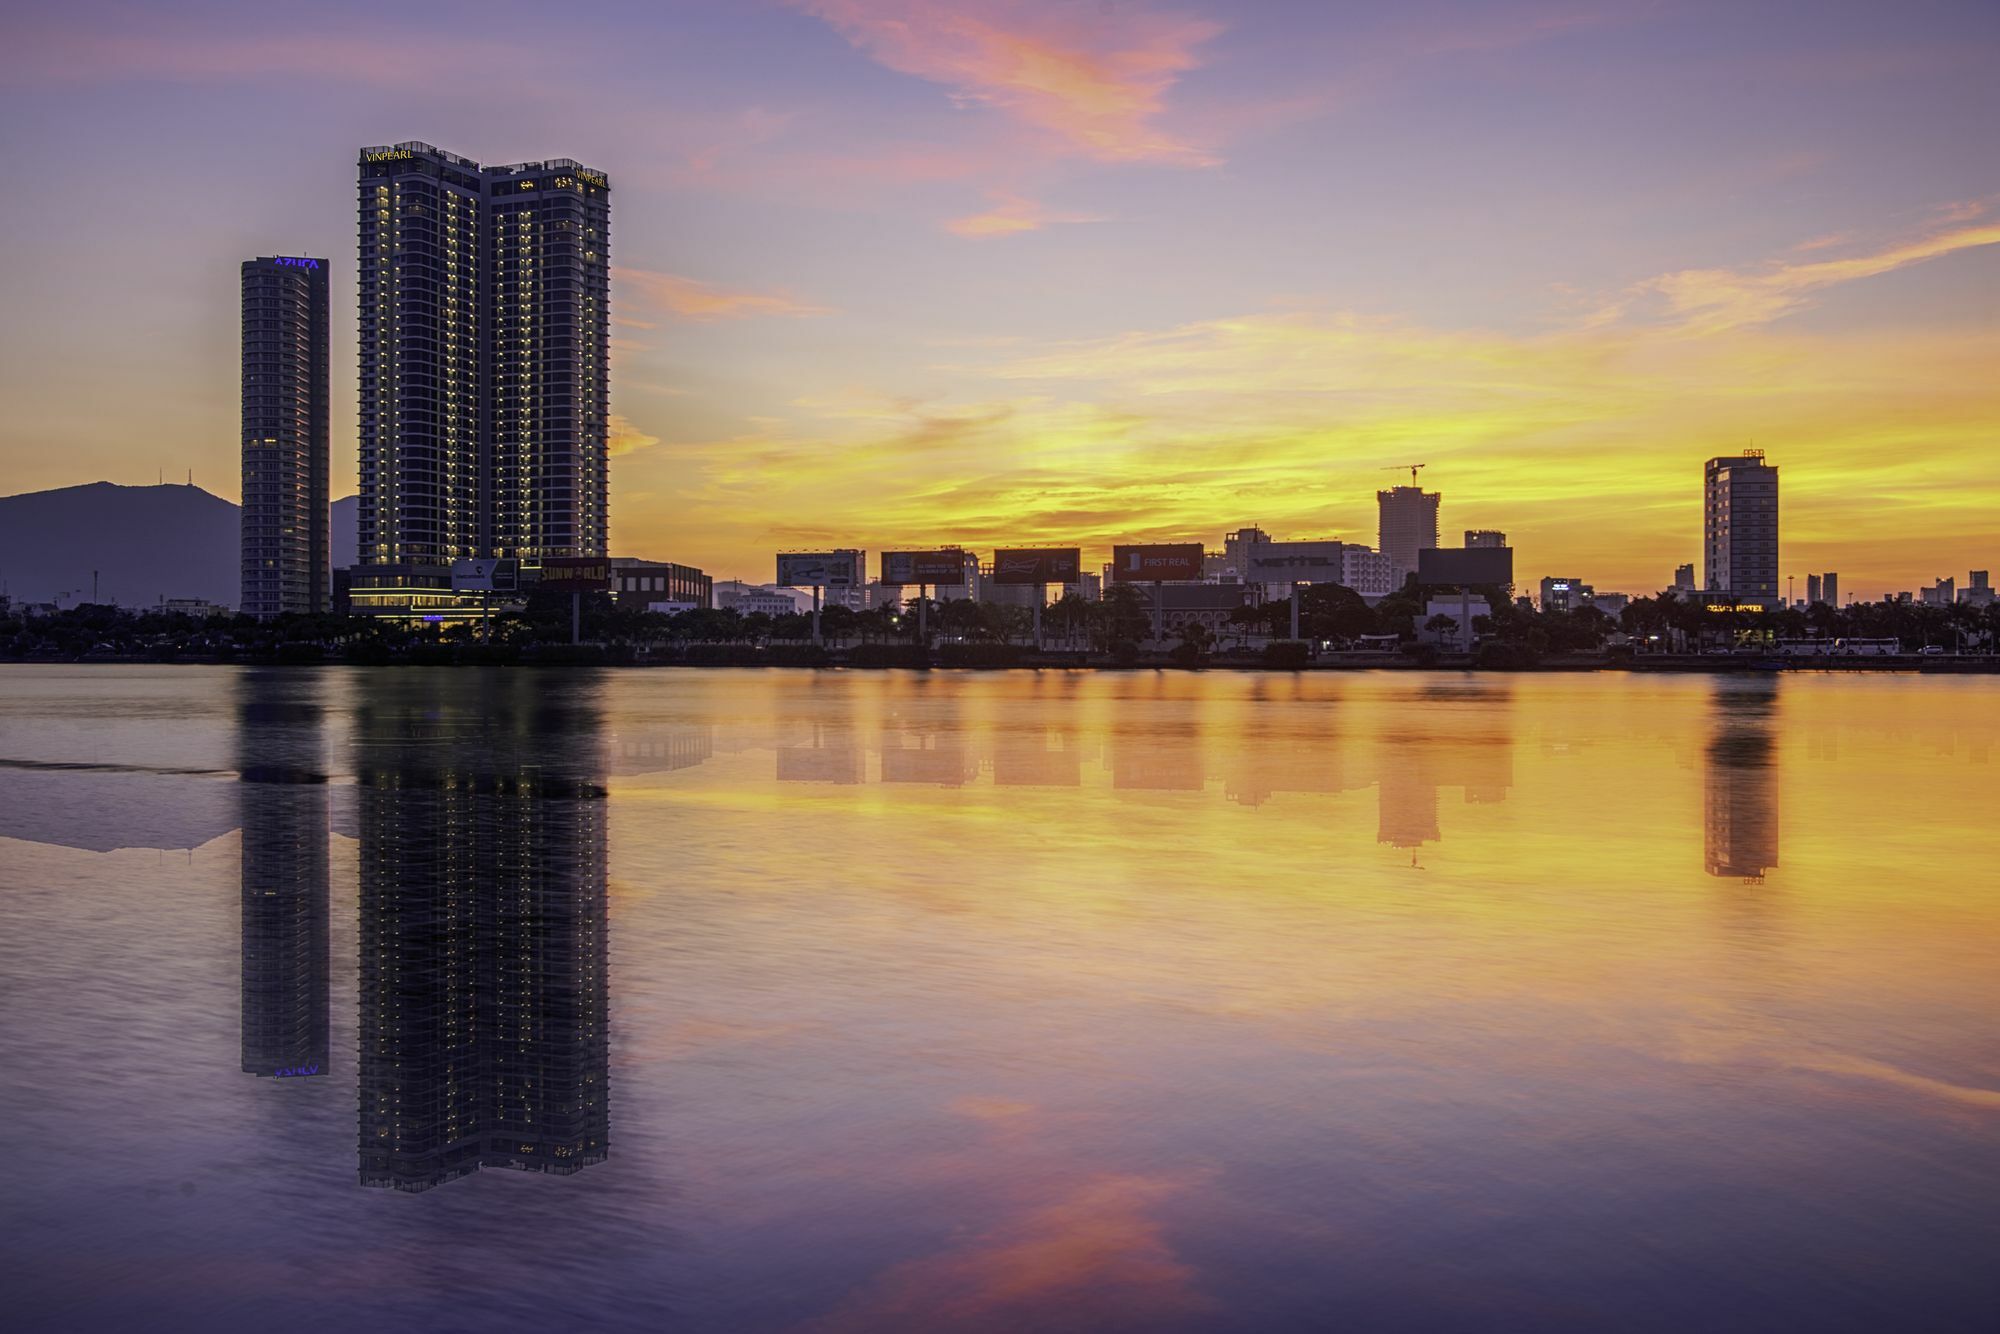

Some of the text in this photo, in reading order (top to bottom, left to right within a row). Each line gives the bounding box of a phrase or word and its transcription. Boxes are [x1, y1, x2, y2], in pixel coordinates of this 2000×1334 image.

[366, 150, 414, 162] VINPEARL
[575, 168, 607, 188] VINPEARL
[1144, 558, 1190, 567] FIRST REAL
